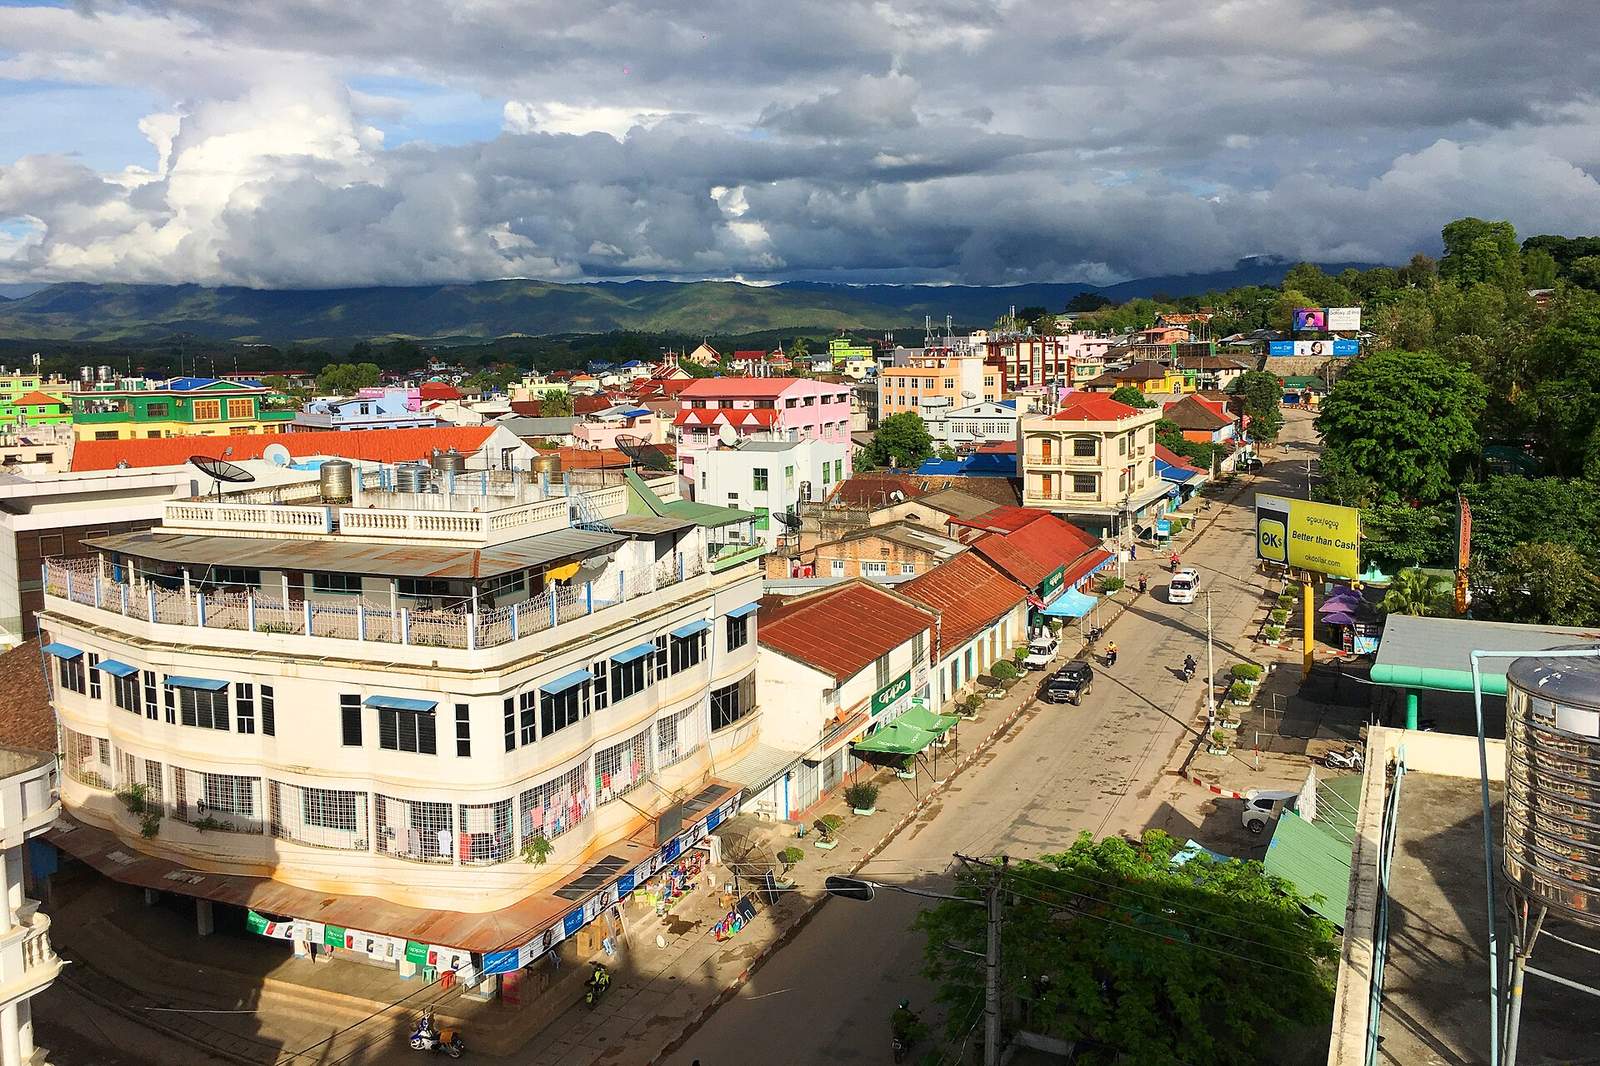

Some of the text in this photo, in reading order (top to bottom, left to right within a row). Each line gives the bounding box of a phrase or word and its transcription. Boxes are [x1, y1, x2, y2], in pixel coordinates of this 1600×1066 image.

[1292, 531, 1356, 550] Better than Cash
